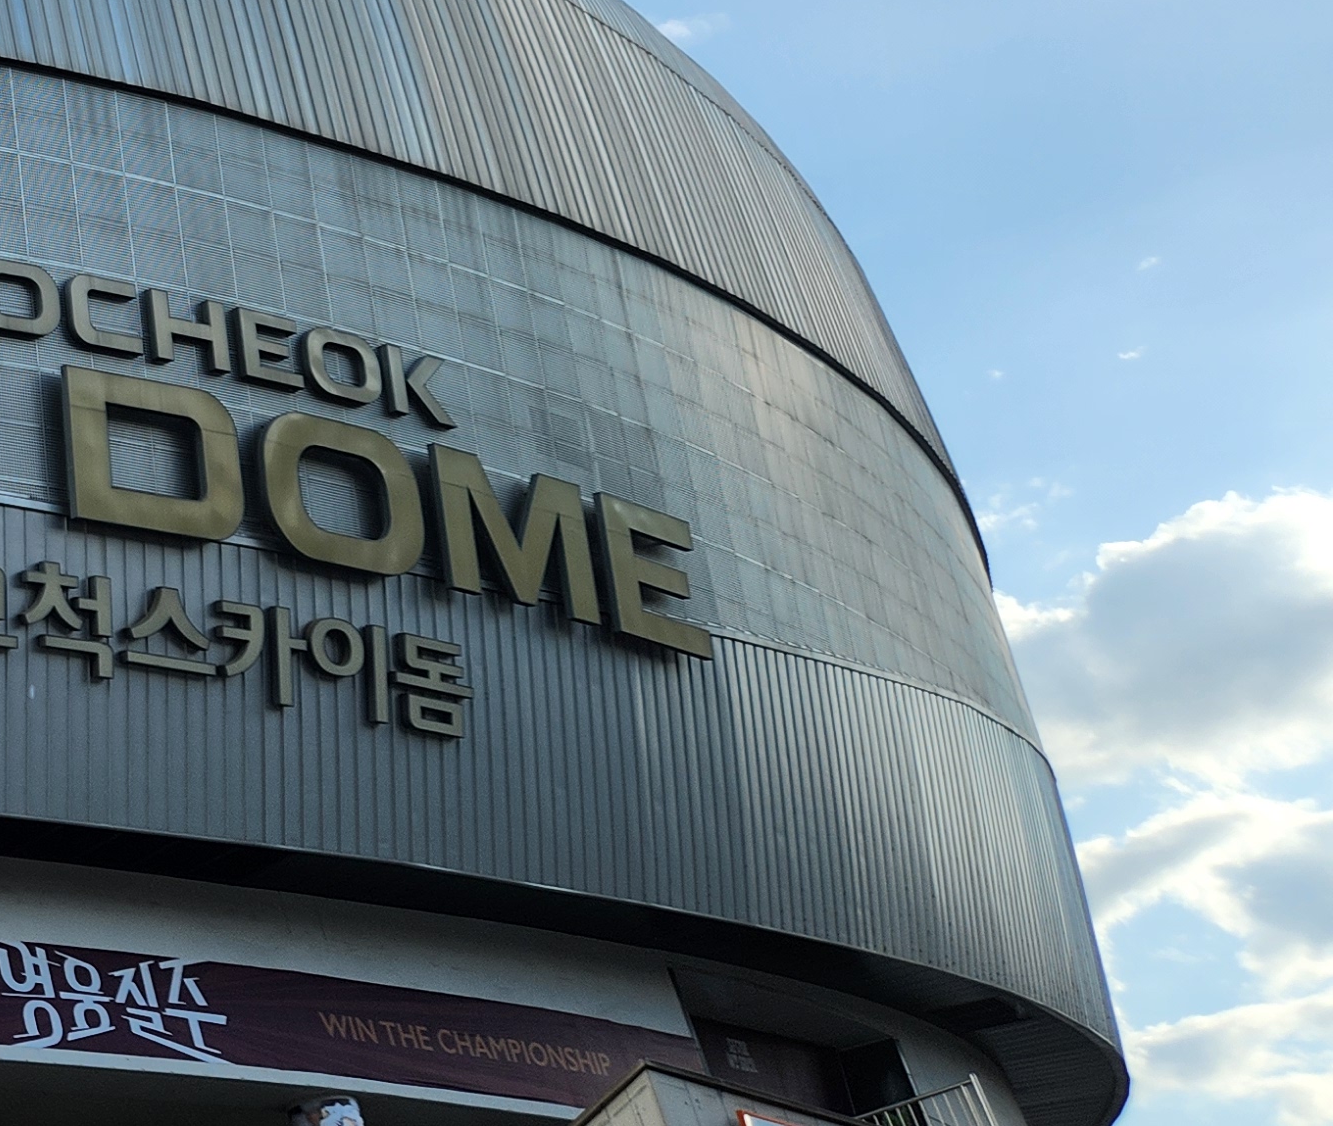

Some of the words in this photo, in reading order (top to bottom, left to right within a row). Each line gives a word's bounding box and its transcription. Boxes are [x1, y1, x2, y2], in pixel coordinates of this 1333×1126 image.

[61, 364, 713, 660] DOME
[318, 1011, 380, 1045] WIN
[379, 1021, 433, 1052] THE
[438, 1028, 612, 1076] CHAMPIONSHIP
